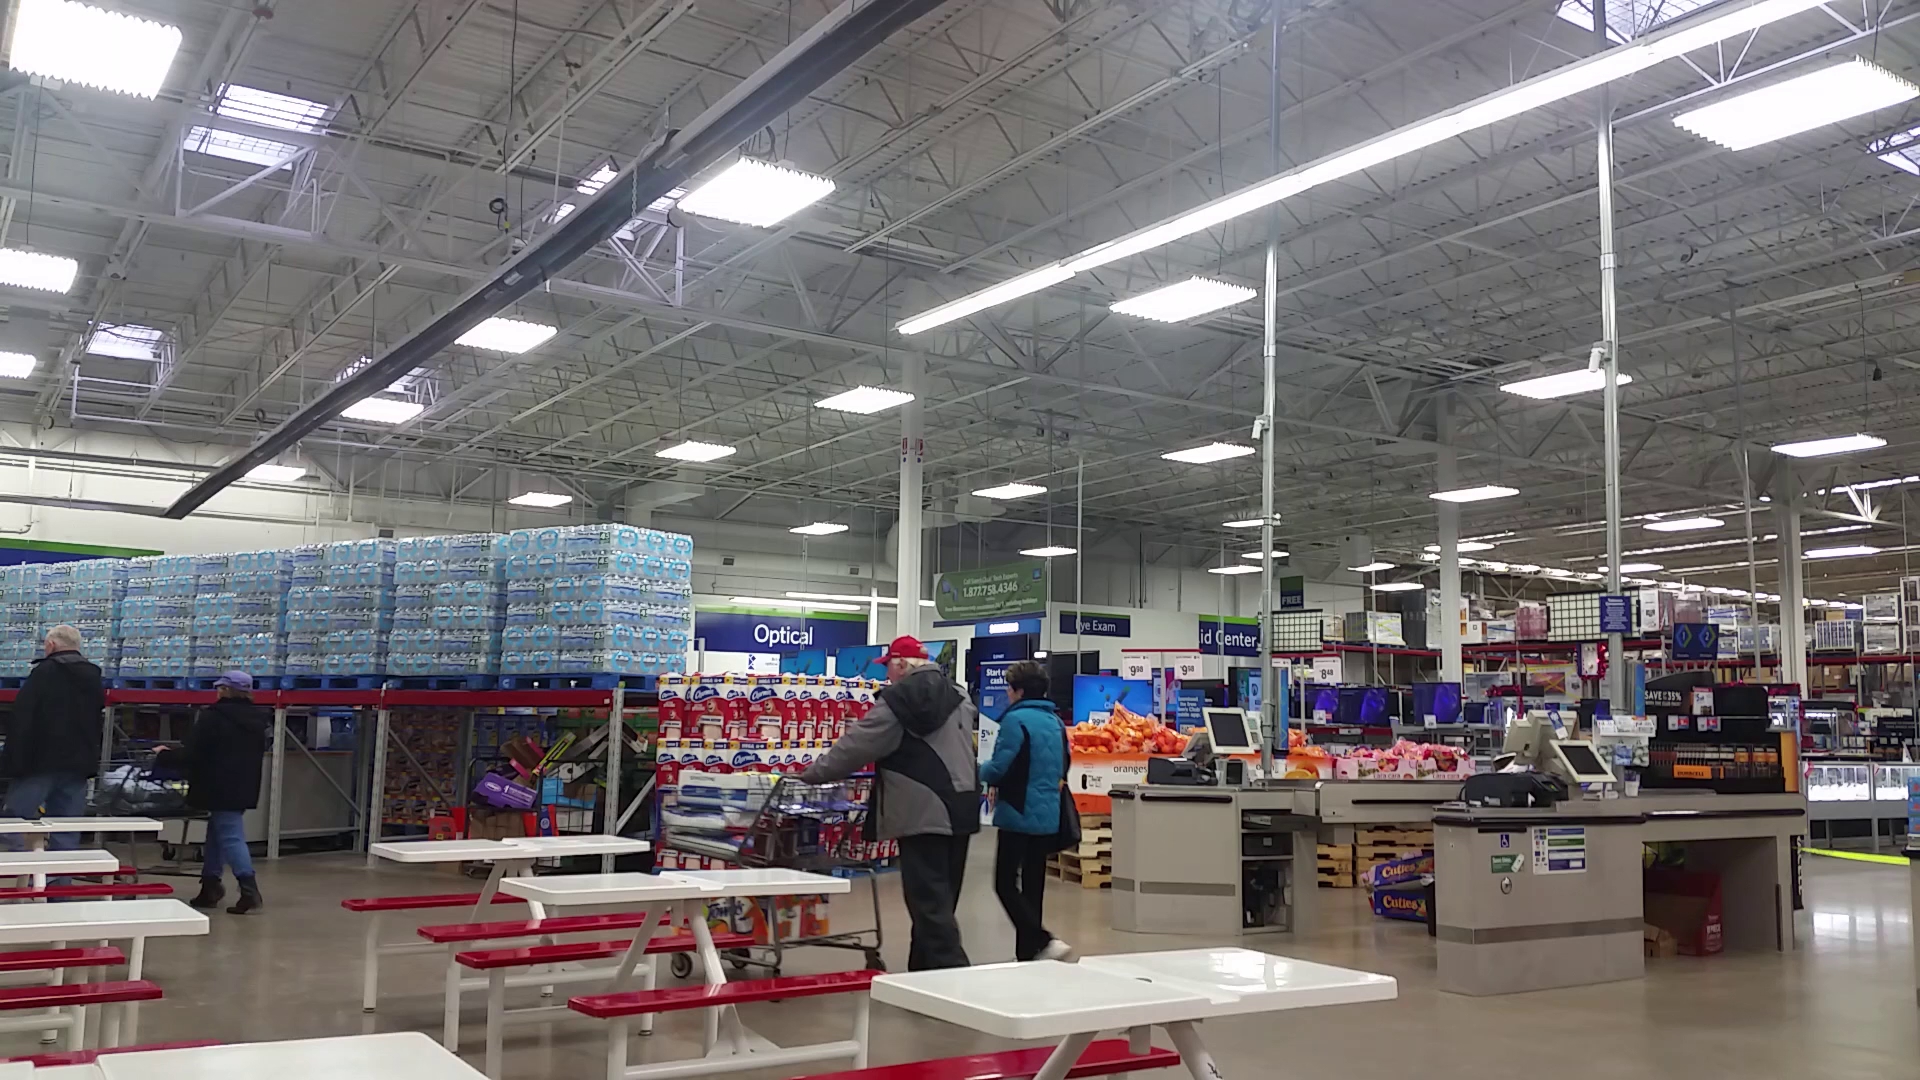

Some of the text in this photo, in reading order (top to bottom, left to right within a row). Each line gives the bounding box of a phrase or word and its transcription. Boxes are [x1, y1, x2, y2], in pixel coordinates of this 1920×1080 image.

[963, 581, 1018, 598] 1.877.758.4346
[1282, 595, 1302, 605] FREE
[1092, 619, 1116, 632] Exam
[754, 623, 813, 647] Optical
[1199, 629, 1257, 647] id Center
[1705, 631, 1710, 641] 2
[986, 668, 1001, 676] Start
[990, 677, 1003, 685] cash
[1644, 690, 1662, 700] SAVE
[1113, 766, 1148, 775] oranges
[1382, 863, 1416, 879] Cuties
[1383, 895, 1418, 910] Cuties
